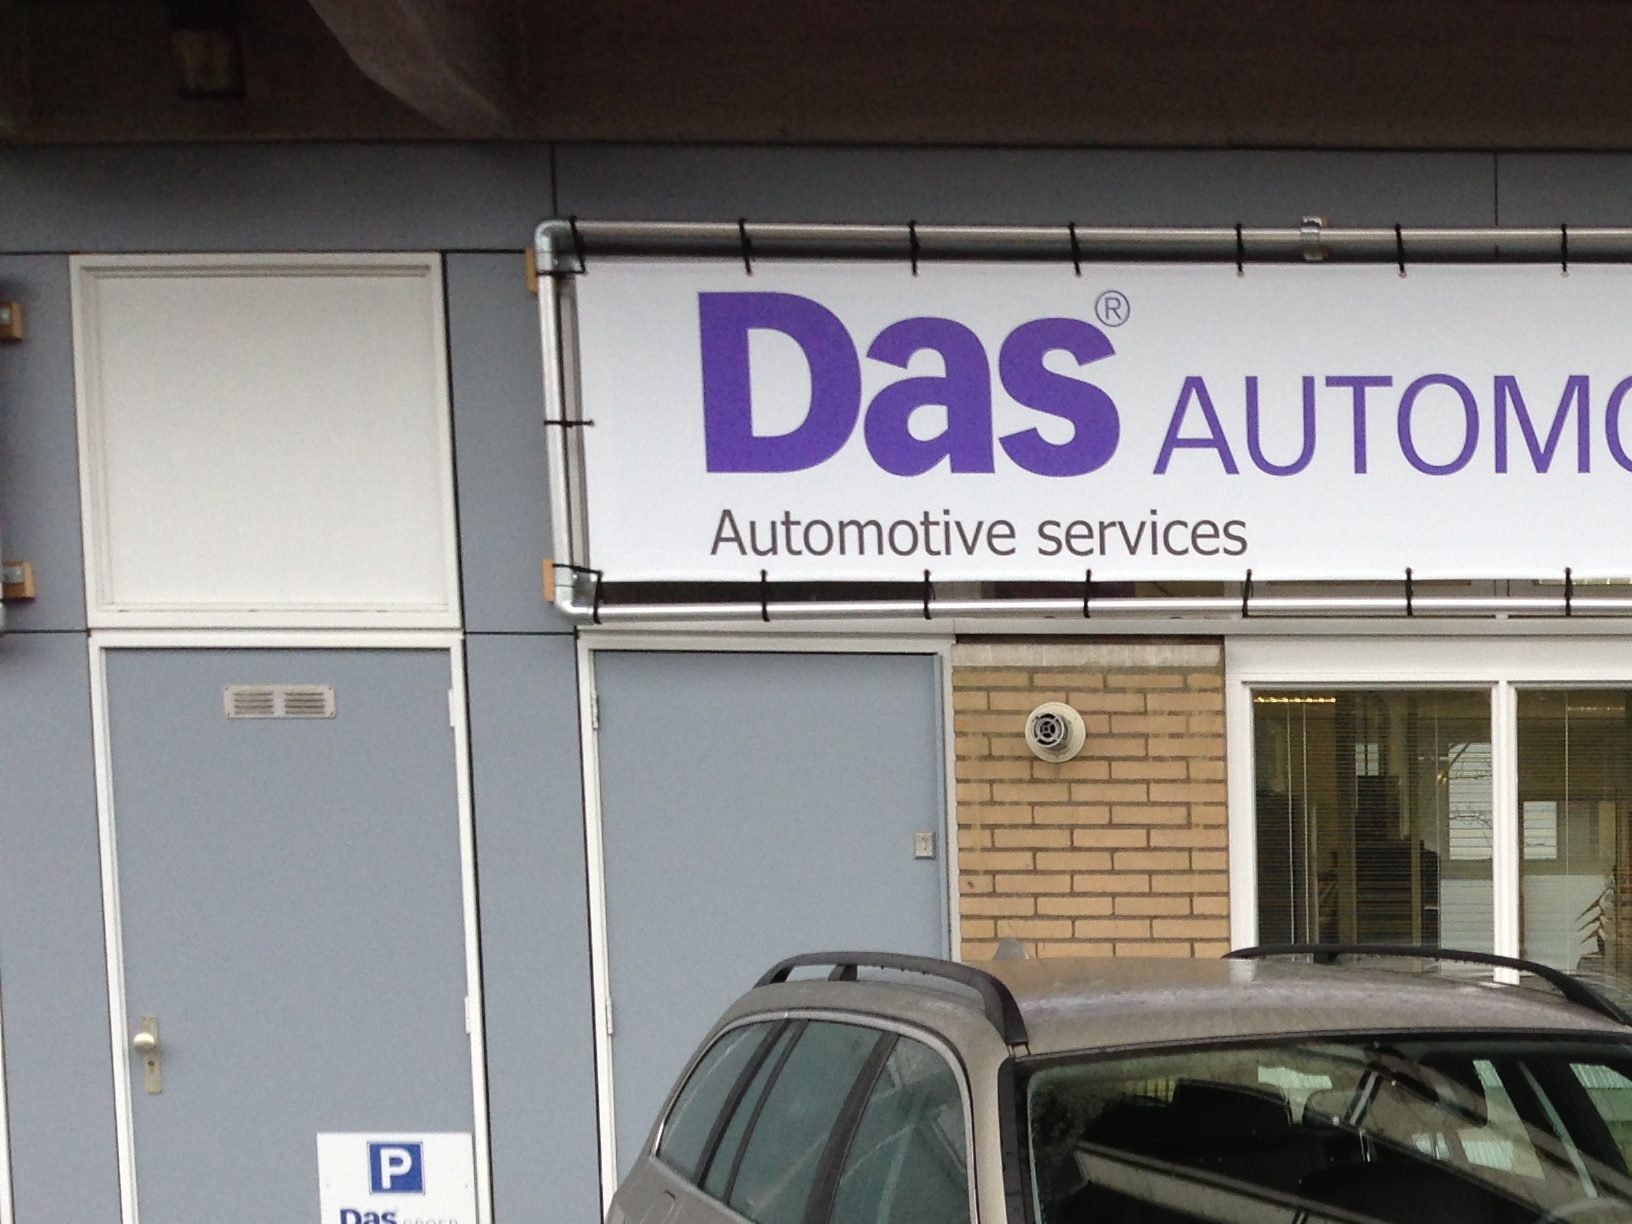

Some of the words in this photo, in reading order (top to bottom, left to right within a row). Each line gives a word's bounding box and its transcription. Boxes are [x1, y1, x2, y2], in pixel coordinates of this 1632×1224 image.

[709, 508, 1017, 558] Automotive
[1037, 508, 1249, 558] services
[380, 1147, 413, 1190] P
